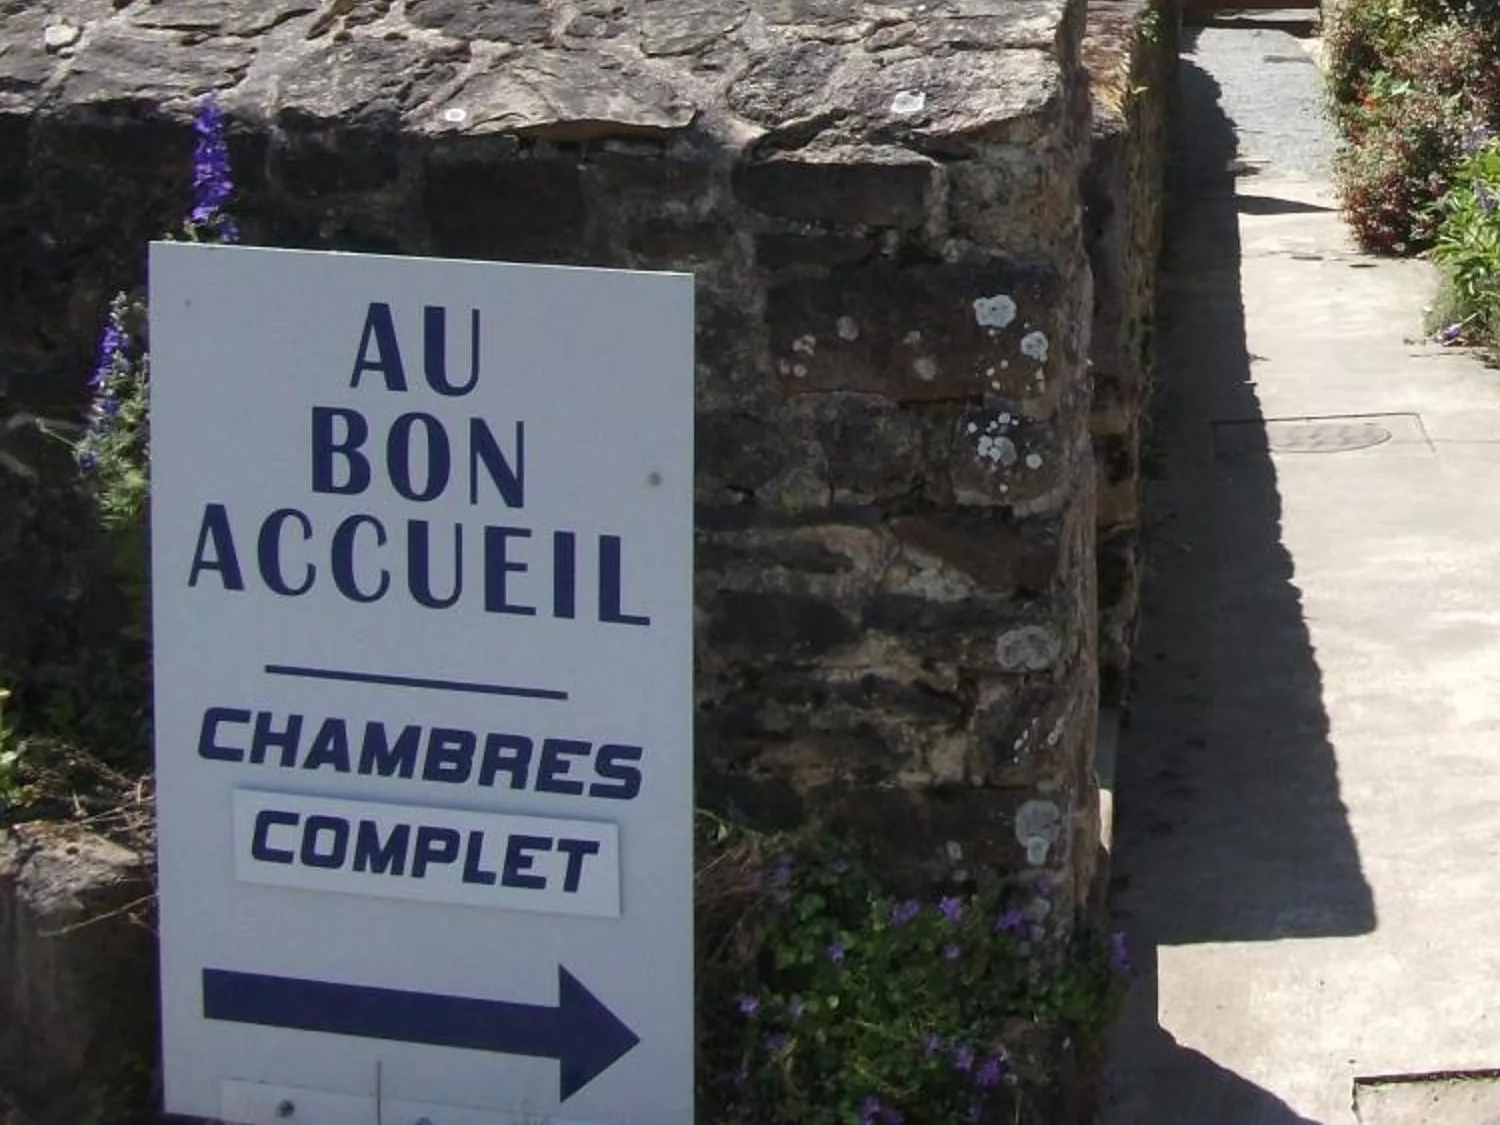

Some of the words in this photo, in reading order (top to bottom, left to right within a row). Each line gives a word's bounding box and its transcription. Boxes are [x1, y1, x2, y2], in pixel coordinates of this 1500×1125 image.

[350, 302, 481, 397] AU
[311, 406, 525, 509] BON
[187, 503, 651, 626] ACCUEIL
[197, 706, 643, 801] CHAMBRES
[251, 810, 601, 893] COMPLET
